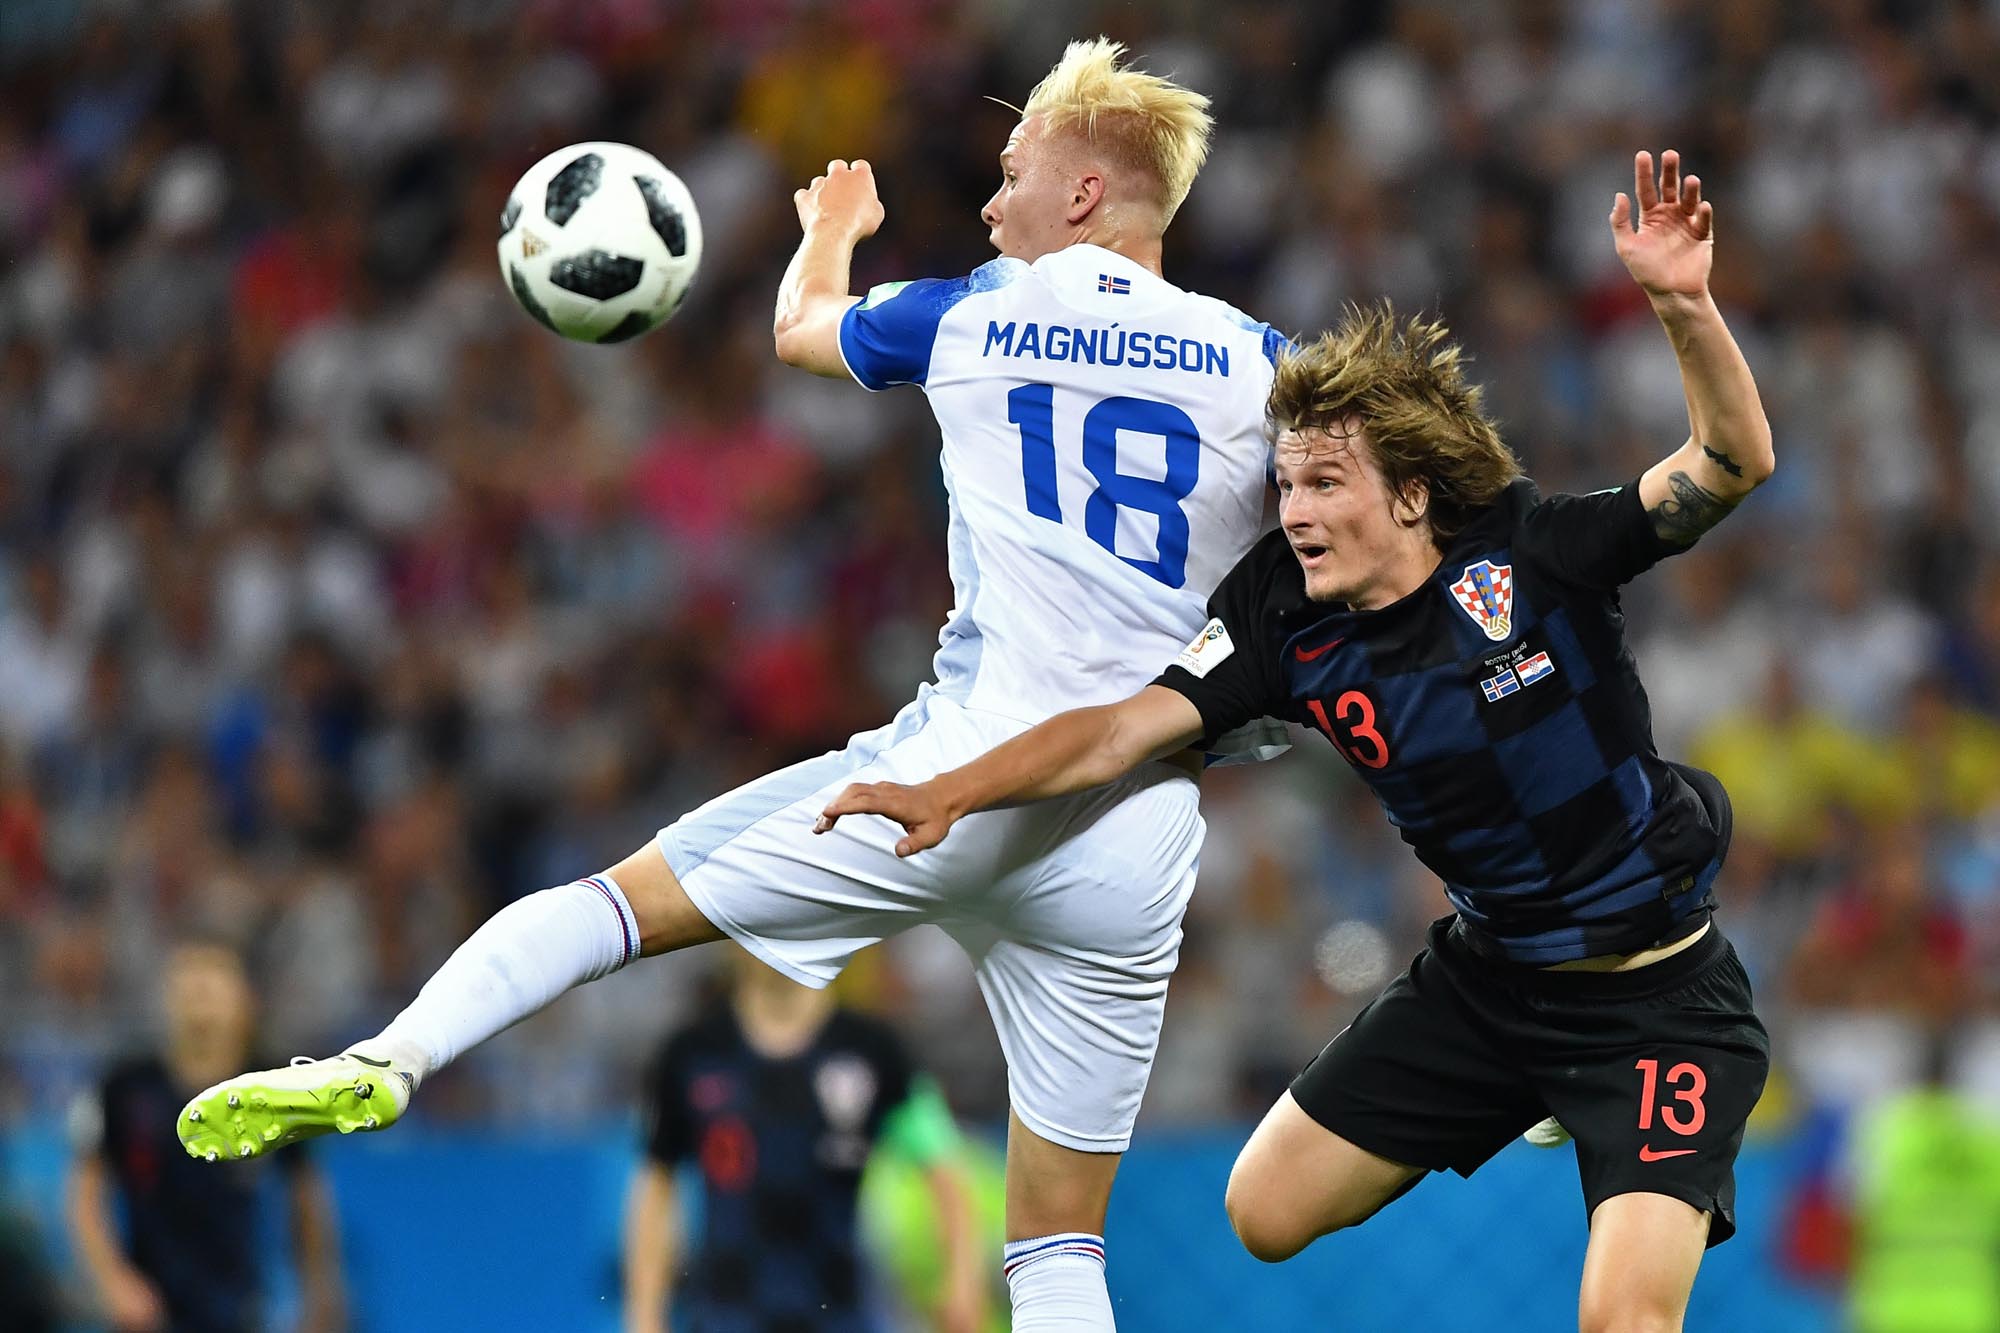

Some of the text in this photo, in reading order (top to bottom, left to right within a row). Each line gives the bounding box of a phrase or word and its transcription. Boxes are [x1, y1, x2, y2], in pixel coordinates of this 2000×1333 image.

[983, 320, 1230, 377] MAGNÚSSON
[1015, 383, 1200, 589] 18
[1306, 690, 1389, 769] 13
[1635, 1059, 1707, 1136] 13
